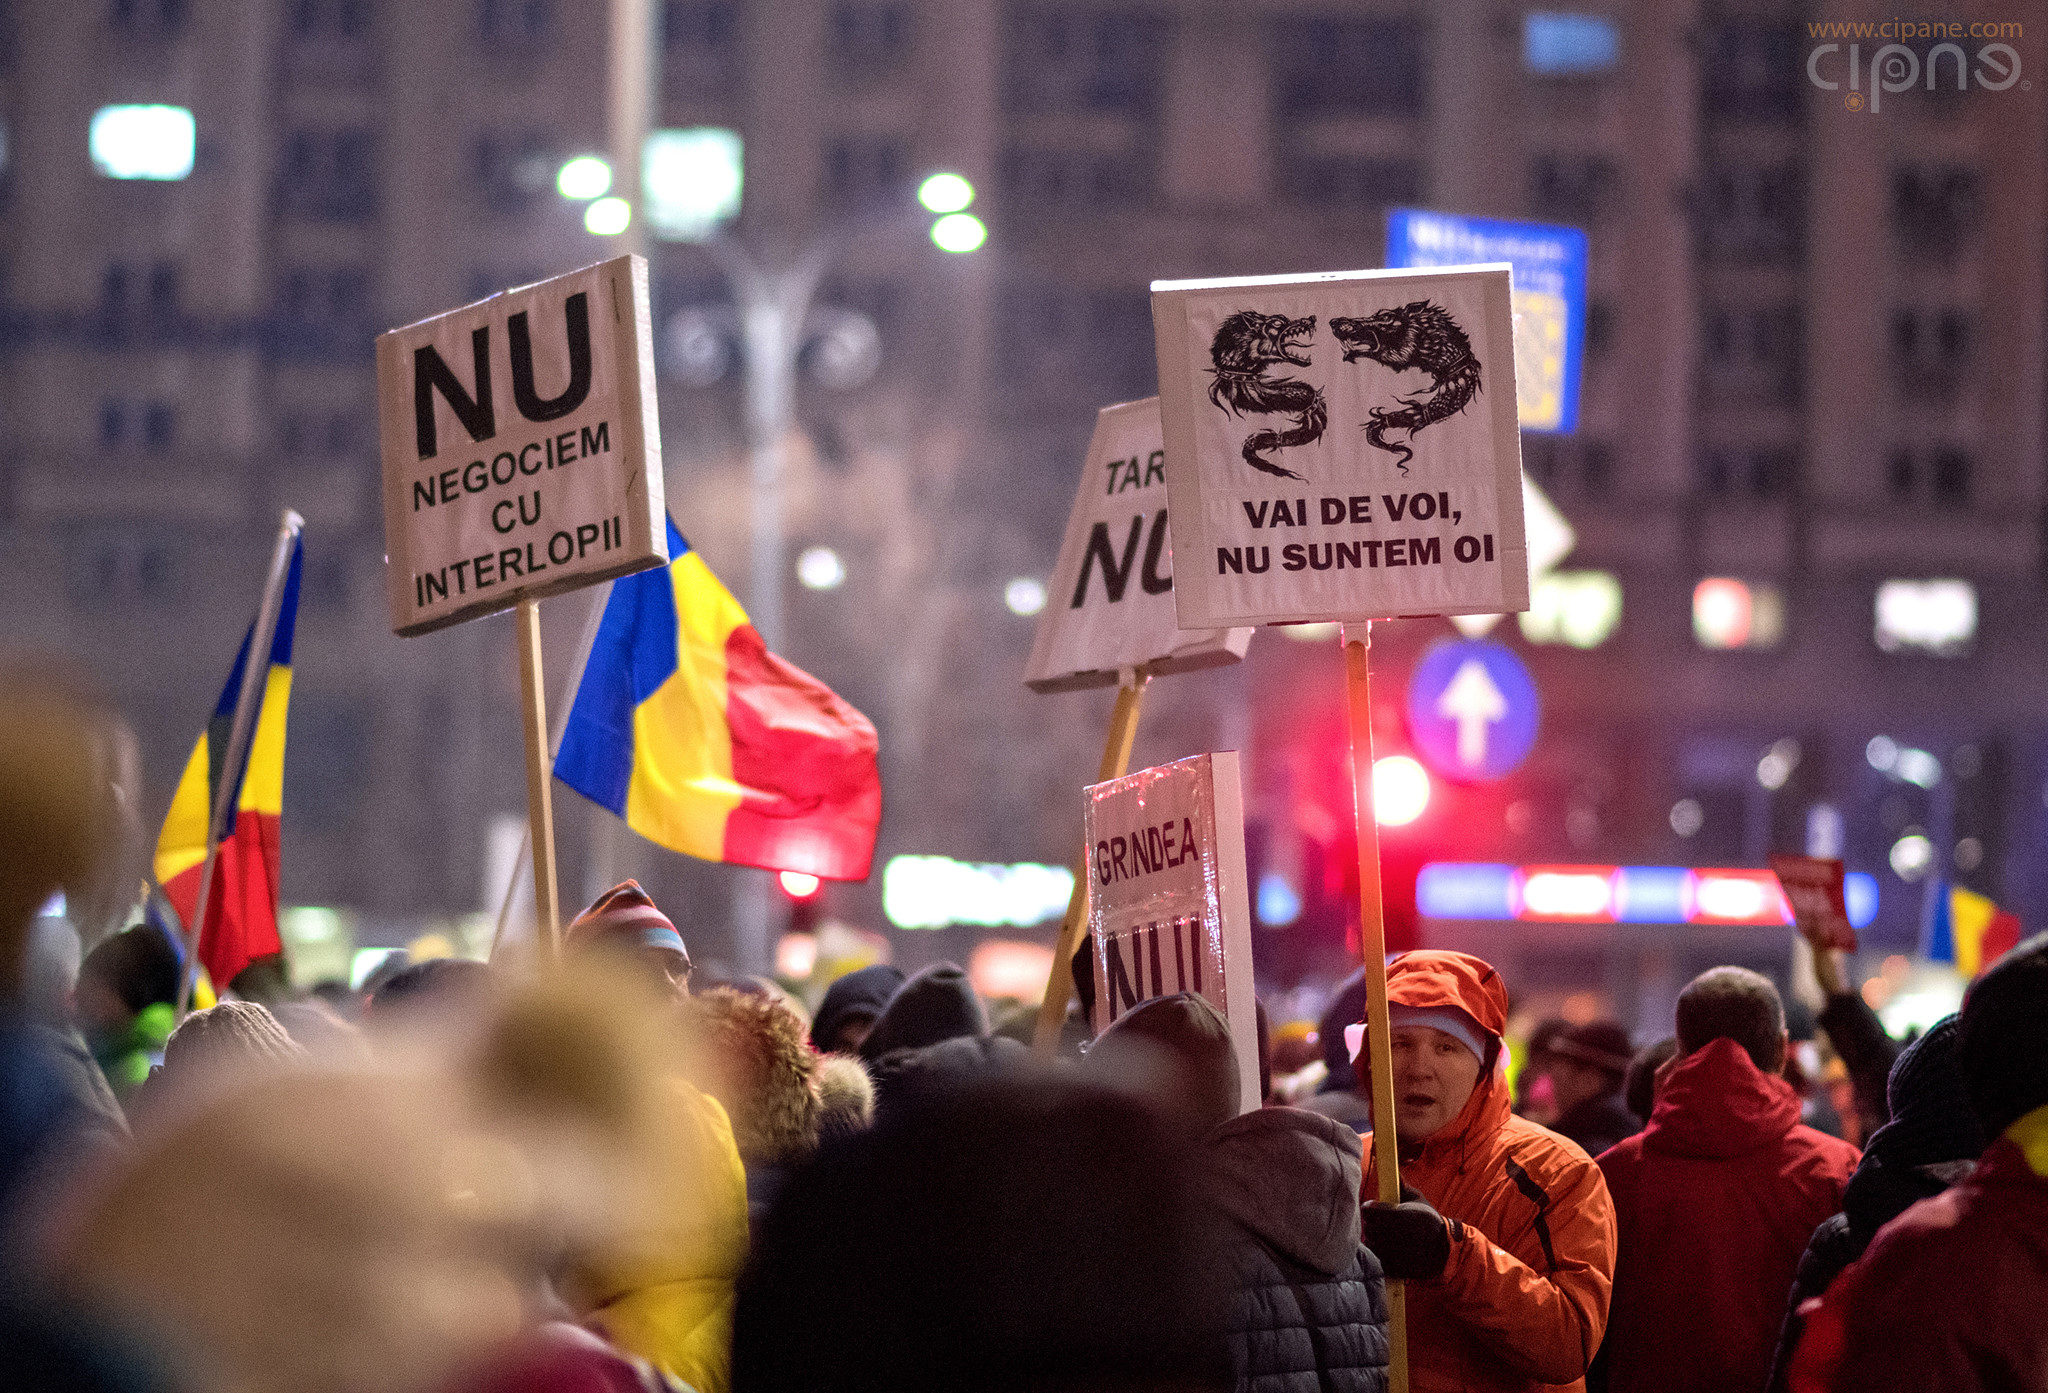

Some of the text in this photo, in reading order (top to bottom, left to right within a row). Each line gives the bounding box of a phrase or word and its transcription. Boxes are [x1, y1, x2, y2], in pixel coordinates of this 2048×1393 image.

[414, 292, 592, 461] NU
[413, 422, 611, 512] NEGOCIEM
[491, 490, 541, 534] CU
[1243, 491, 1462, 528] VAI DE VOI,
[415, 516, 622, 607] INTERLOPII
[1217, 534, 1494, 575] NU SUNTEM OI
